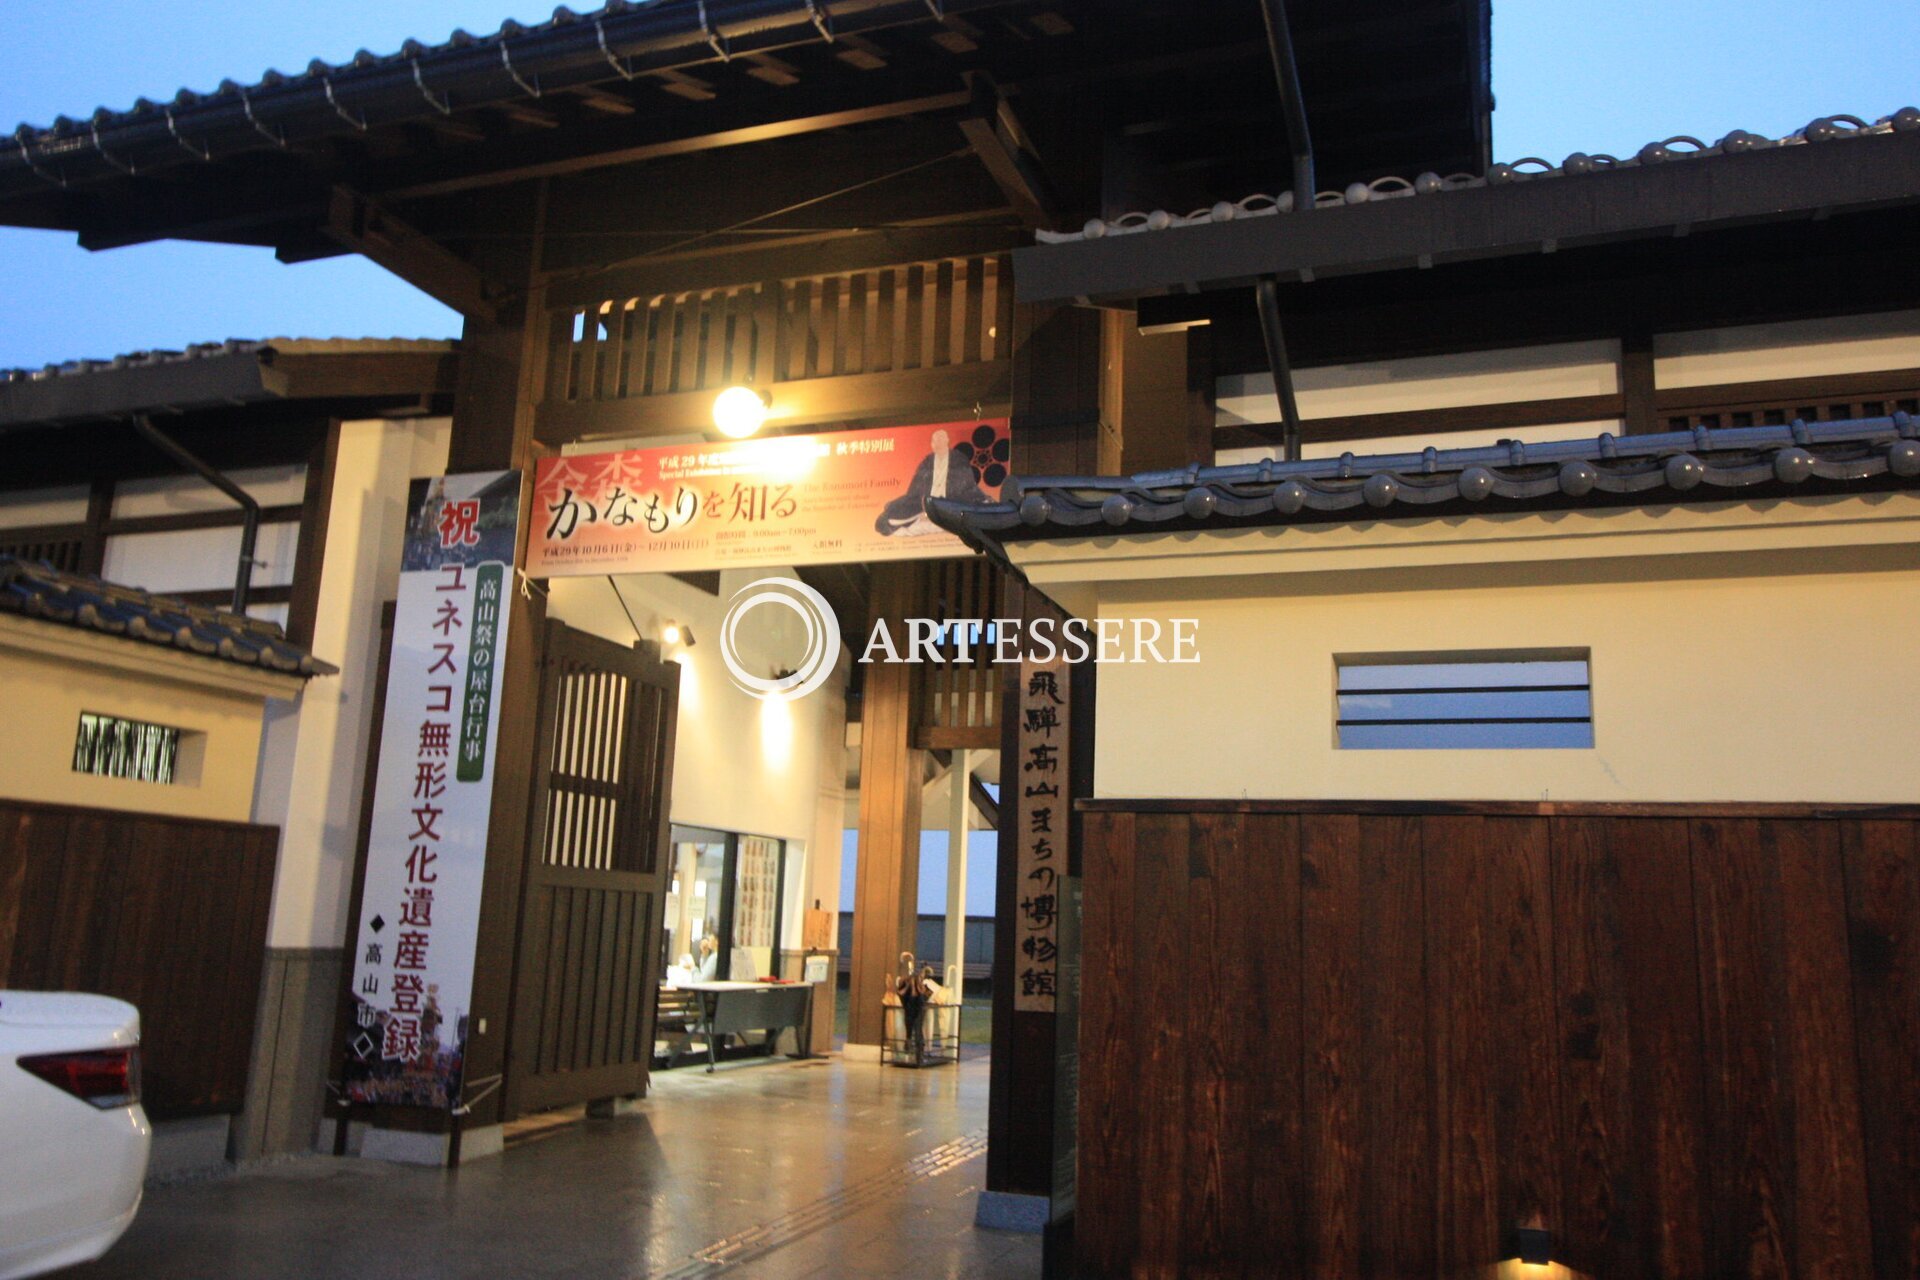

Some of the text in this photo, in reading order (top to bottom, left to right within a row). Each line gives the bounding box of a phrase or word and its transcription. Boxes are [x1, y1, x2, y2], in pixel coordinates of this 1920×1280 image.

[546, 482, 797, 540] かなもりを知る
[870, 478, 901, 490] Family
[464, 578, 497, 763] 高山祭の屋台行事
[383, 565, 467, 1062] ユネスコ無形文化遺産登録
[357, 941, 382, 1029] 高山市
